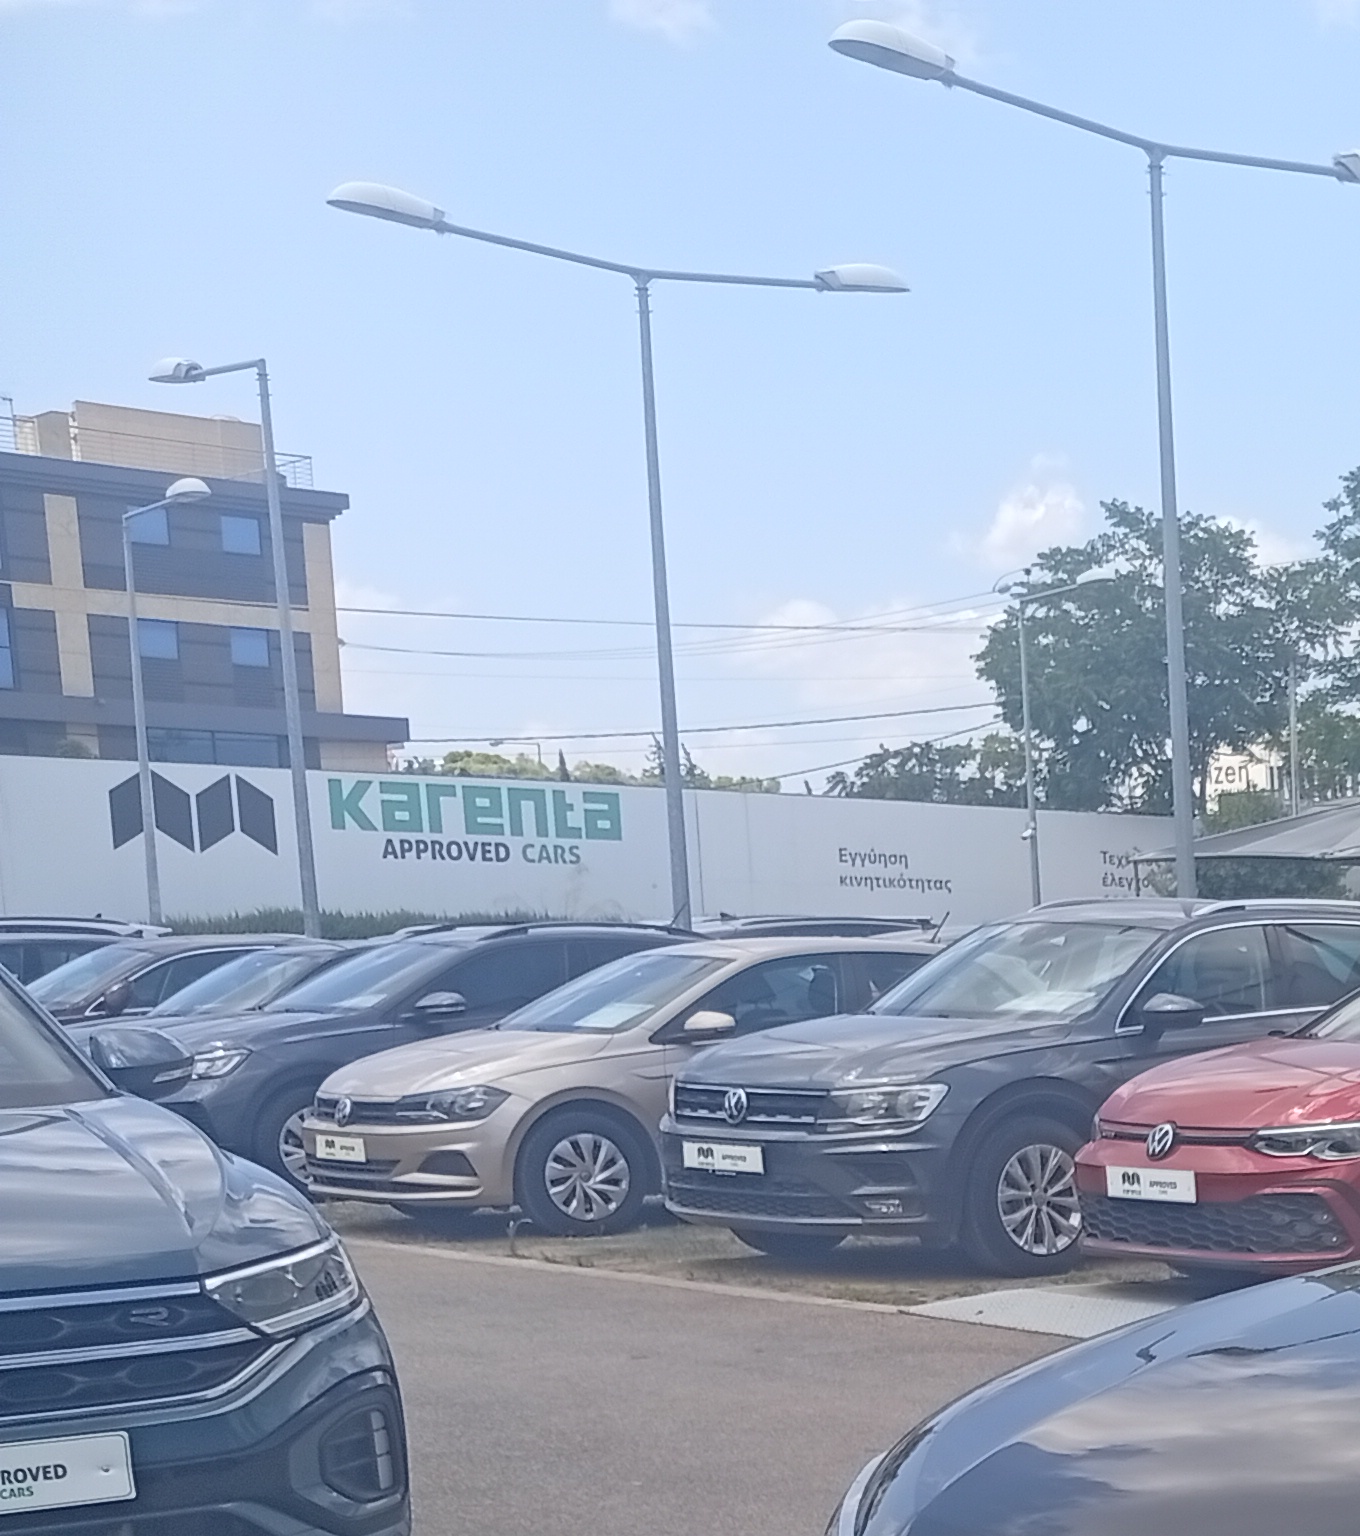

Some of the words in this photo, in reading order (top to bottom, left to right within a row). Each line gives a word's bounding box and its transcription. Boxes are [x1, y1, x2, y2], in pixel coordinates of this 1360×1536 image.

[382, 838, 511, 863] APPROVED
[521, 843, 581, 864] CARS
[838, 847, 909, 869] Εγγύηση
[839, 873, 952, 894] κινητικότητας
[0, 1485, 34, 1500] CARS
